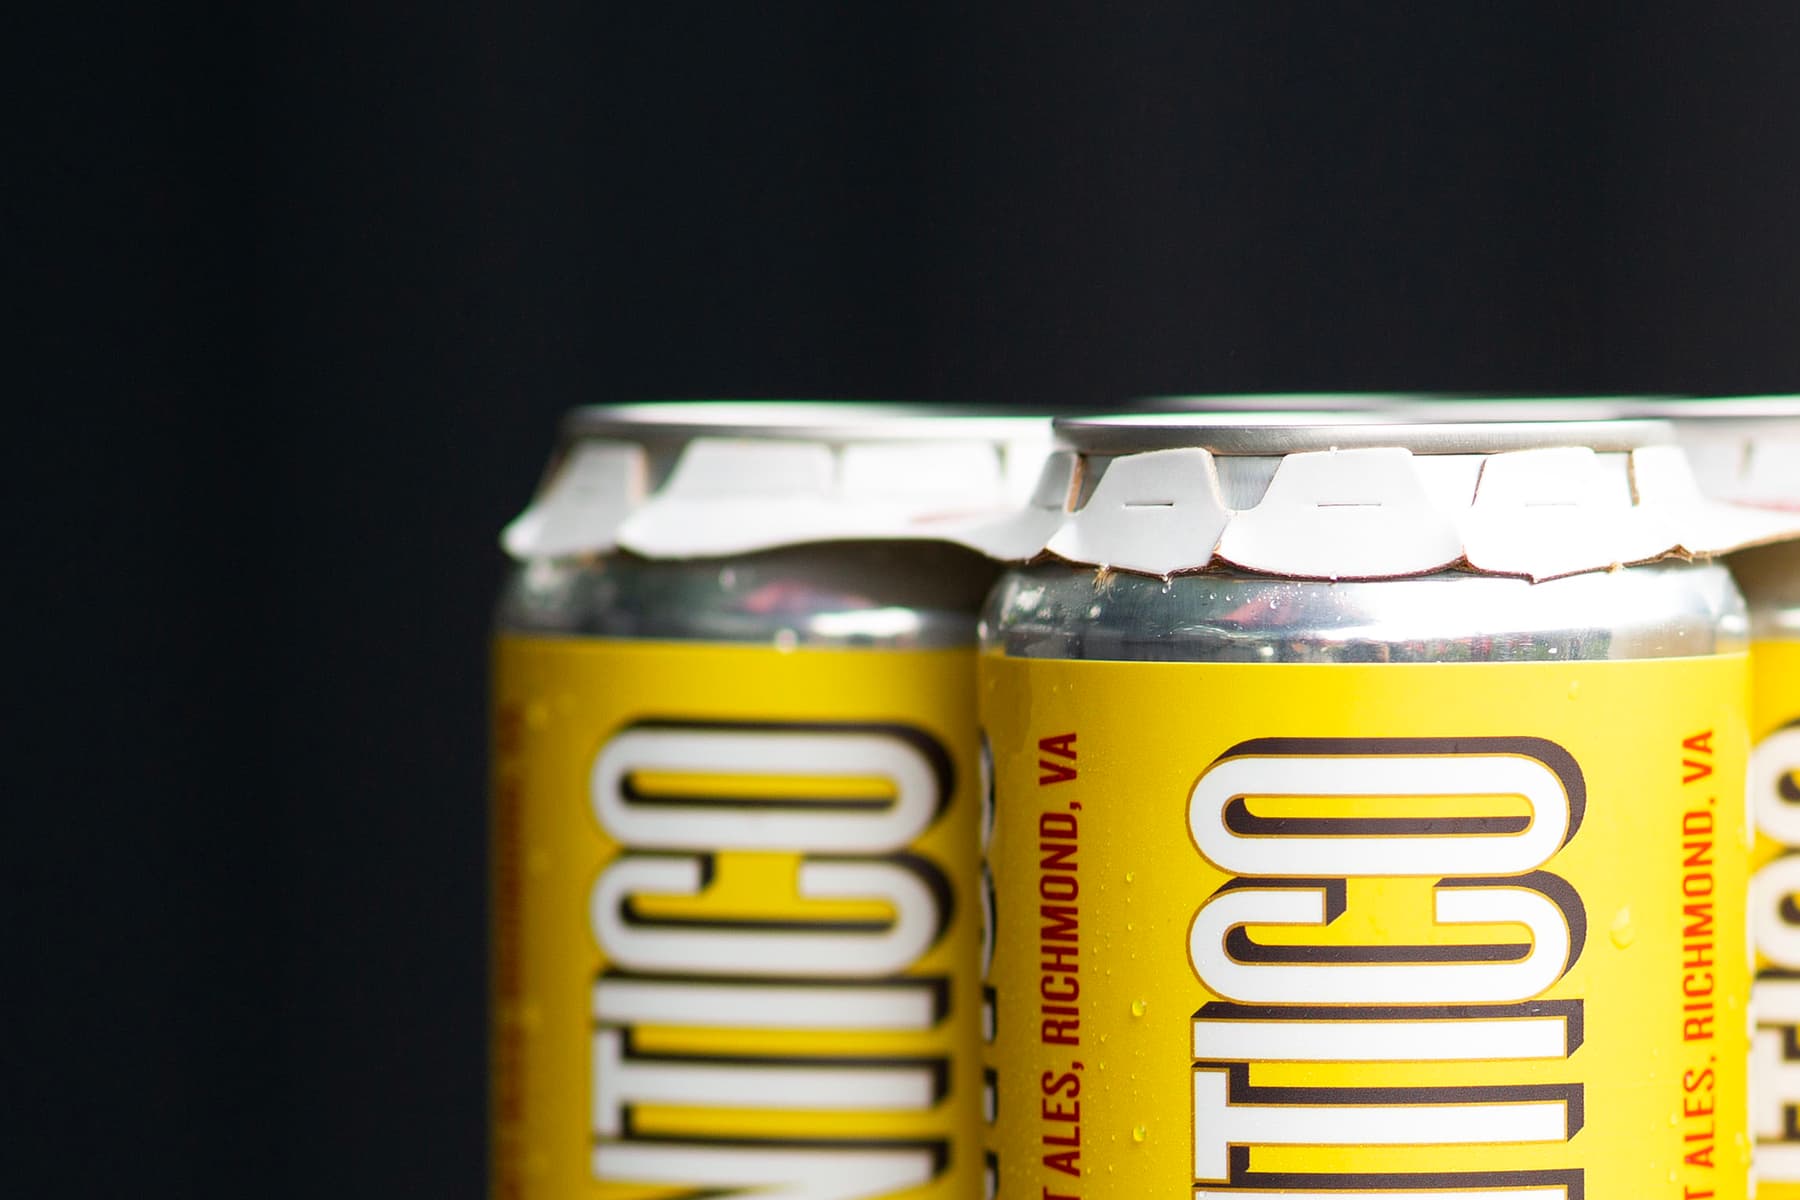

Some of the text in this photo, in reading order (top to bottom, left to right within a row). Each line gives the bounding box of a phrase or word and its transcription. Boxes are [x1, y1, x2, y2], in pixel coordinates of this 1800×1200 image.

[1038, 732, 1078, 787] VA
[1681, 729, 1714, 785] VA
[1039, 799, 1082, 1047] RICHMOND,
[1682, 796, 1716, 1043] RICHMOND,
[1041, 1061, 1084, 1179] ALES,
[1683, 1054, 1717, 1170] ALES,
